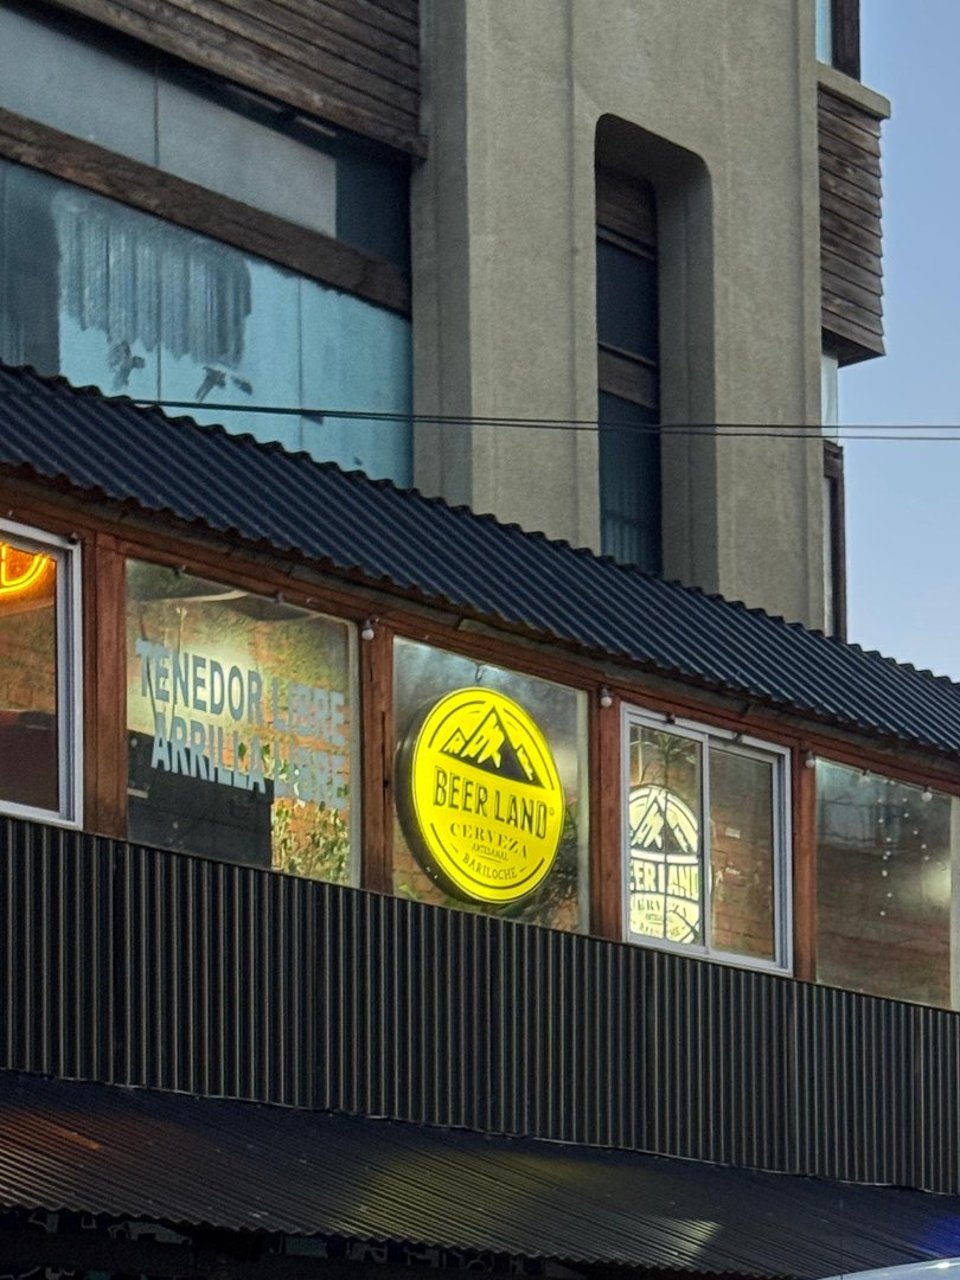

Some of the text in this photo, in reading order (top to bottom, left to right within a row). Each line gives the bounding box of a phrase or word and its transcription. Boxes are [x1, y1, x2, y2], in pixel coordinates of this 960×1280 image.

[135, 637, 345, 747] TENEDOR LIBRE
[433, 765, 548, 839] BEER LAND
[450, 822, 527, 859] CERVEZA
[462, 853, 518, 880] BARILOCHE
